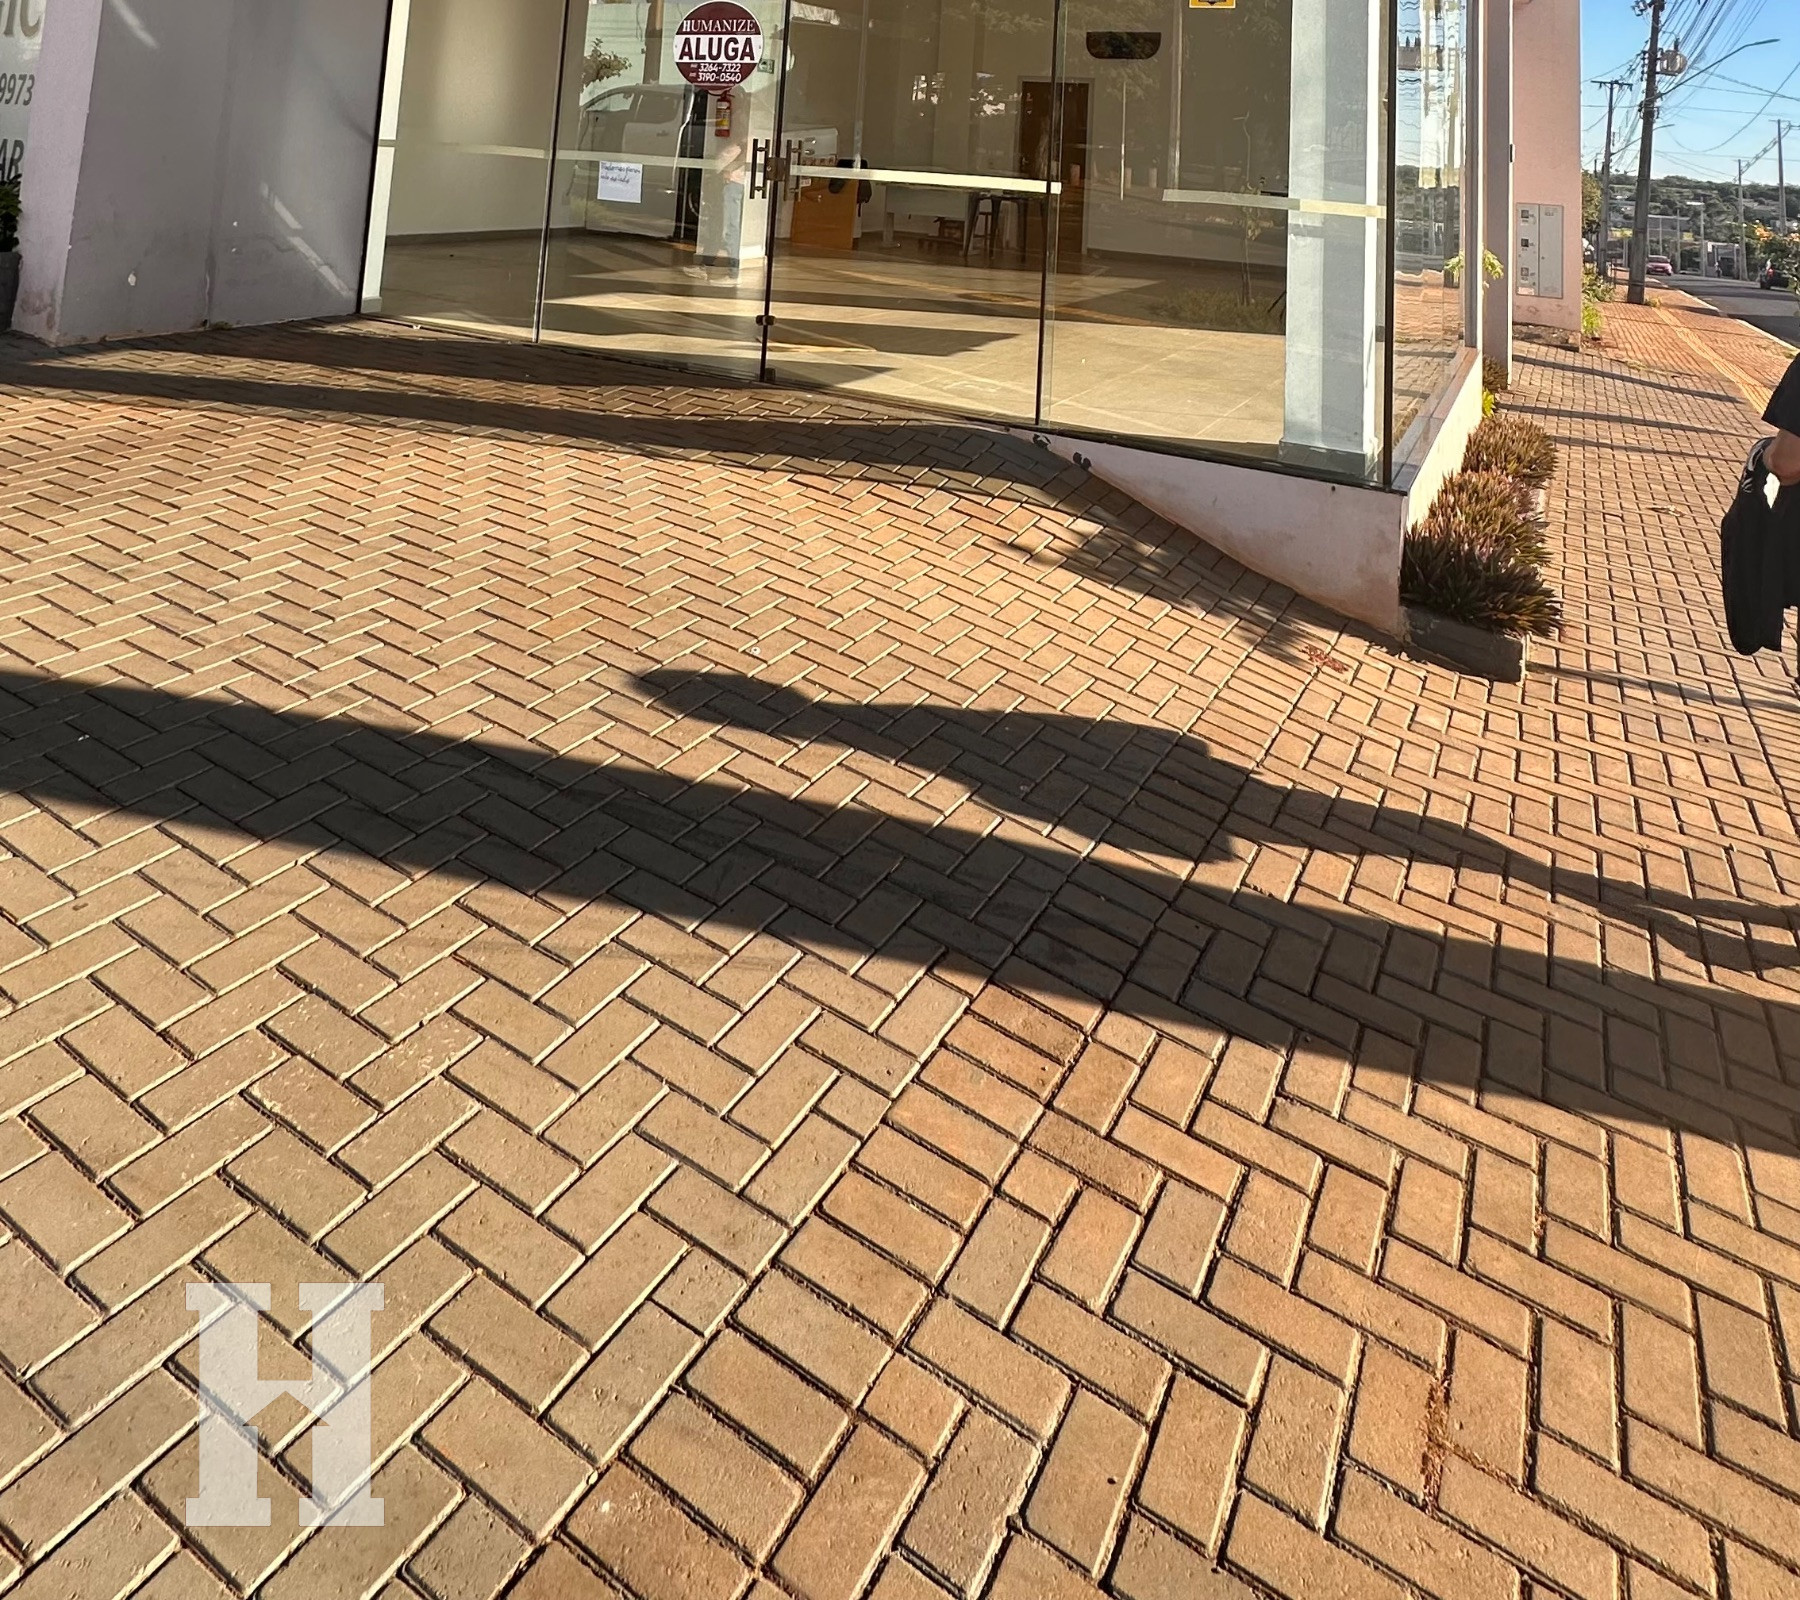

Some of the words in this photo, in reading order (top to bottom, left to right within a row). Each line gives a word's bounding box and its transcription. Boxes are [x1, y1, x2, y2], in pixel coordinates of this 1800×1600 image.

[682, 19, 756, 32] HUMANIZE
[678, 37, 756, 61] ALUGA
[698, 63, 741, 72] 3264-7322
[697, 72, 742, 82] 3190-0540
